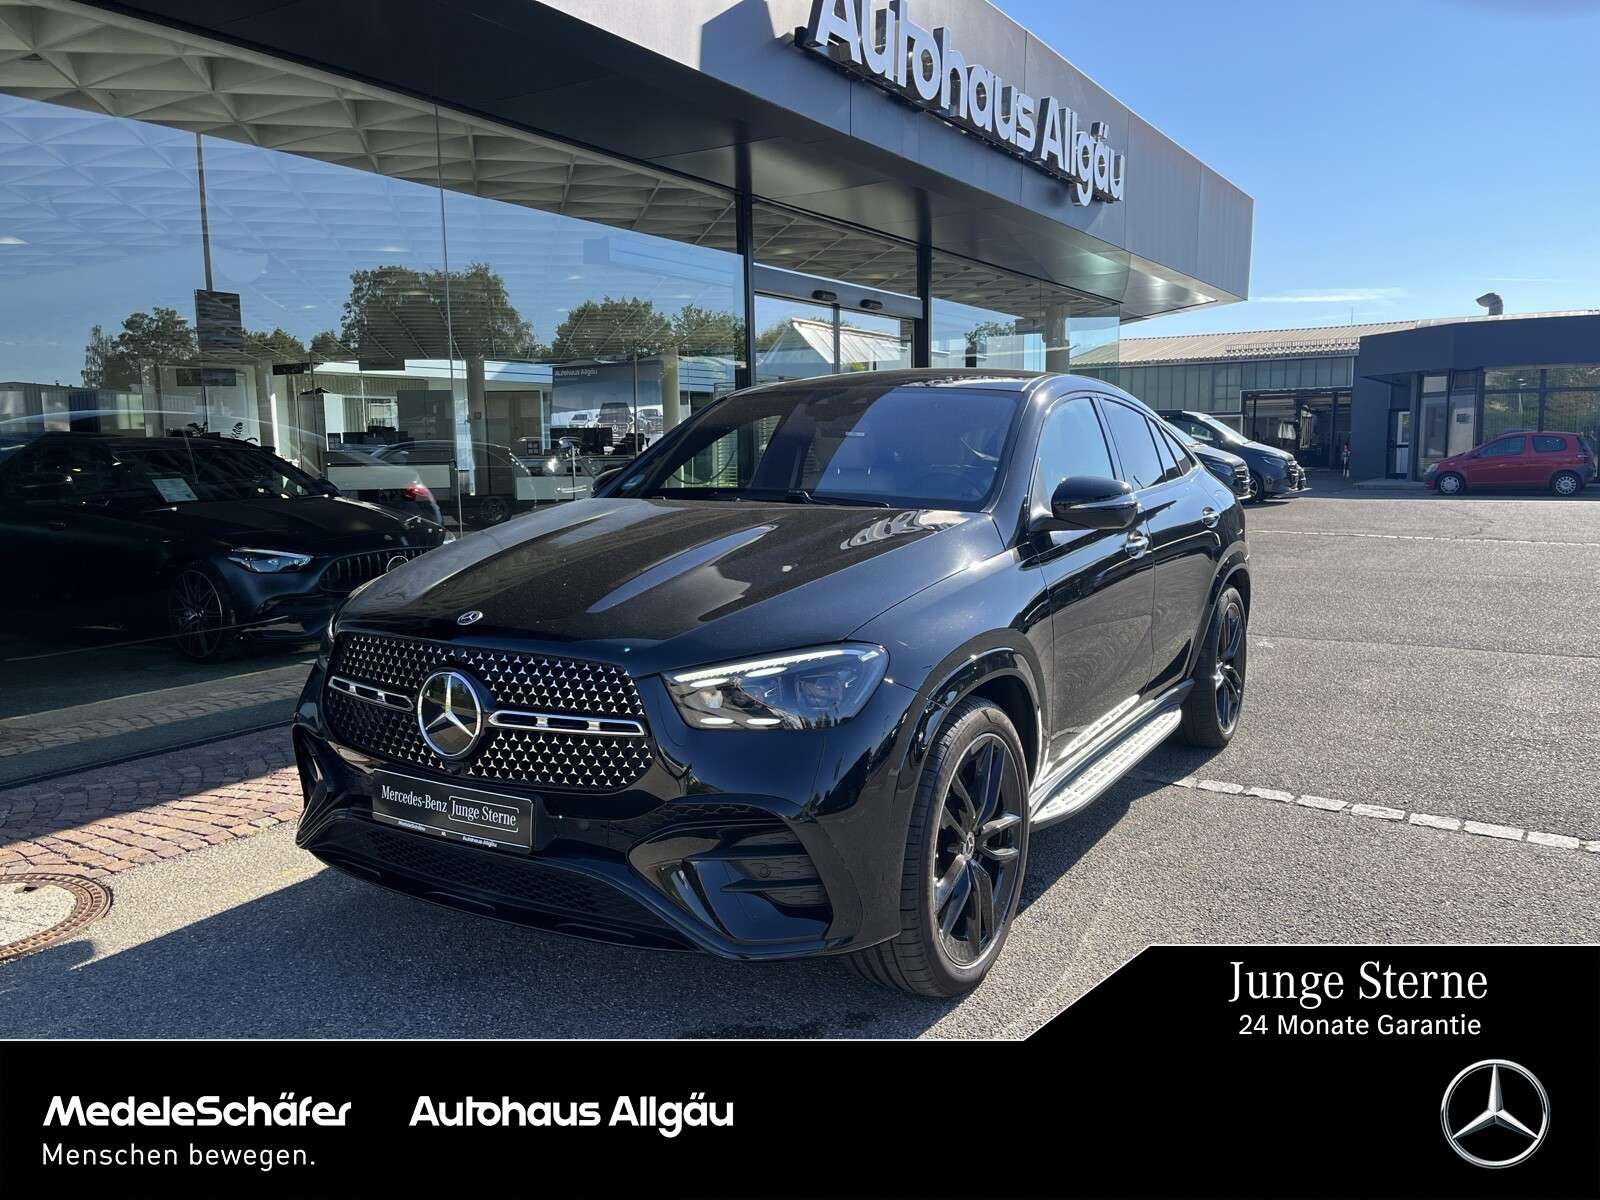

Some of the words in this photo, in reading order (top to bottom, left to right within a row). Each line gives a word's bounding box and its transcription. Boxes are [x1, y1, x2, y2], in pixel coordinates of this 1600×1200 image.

[813, 0, 1036, 152] Autohaus
[1041, 96, 1125, 207] Allgäu
[381, 784, 447, 813] Mercedes-Benz
[450, 800, 480, 821] Junge
[481, 806, 517, 827] Sterne
